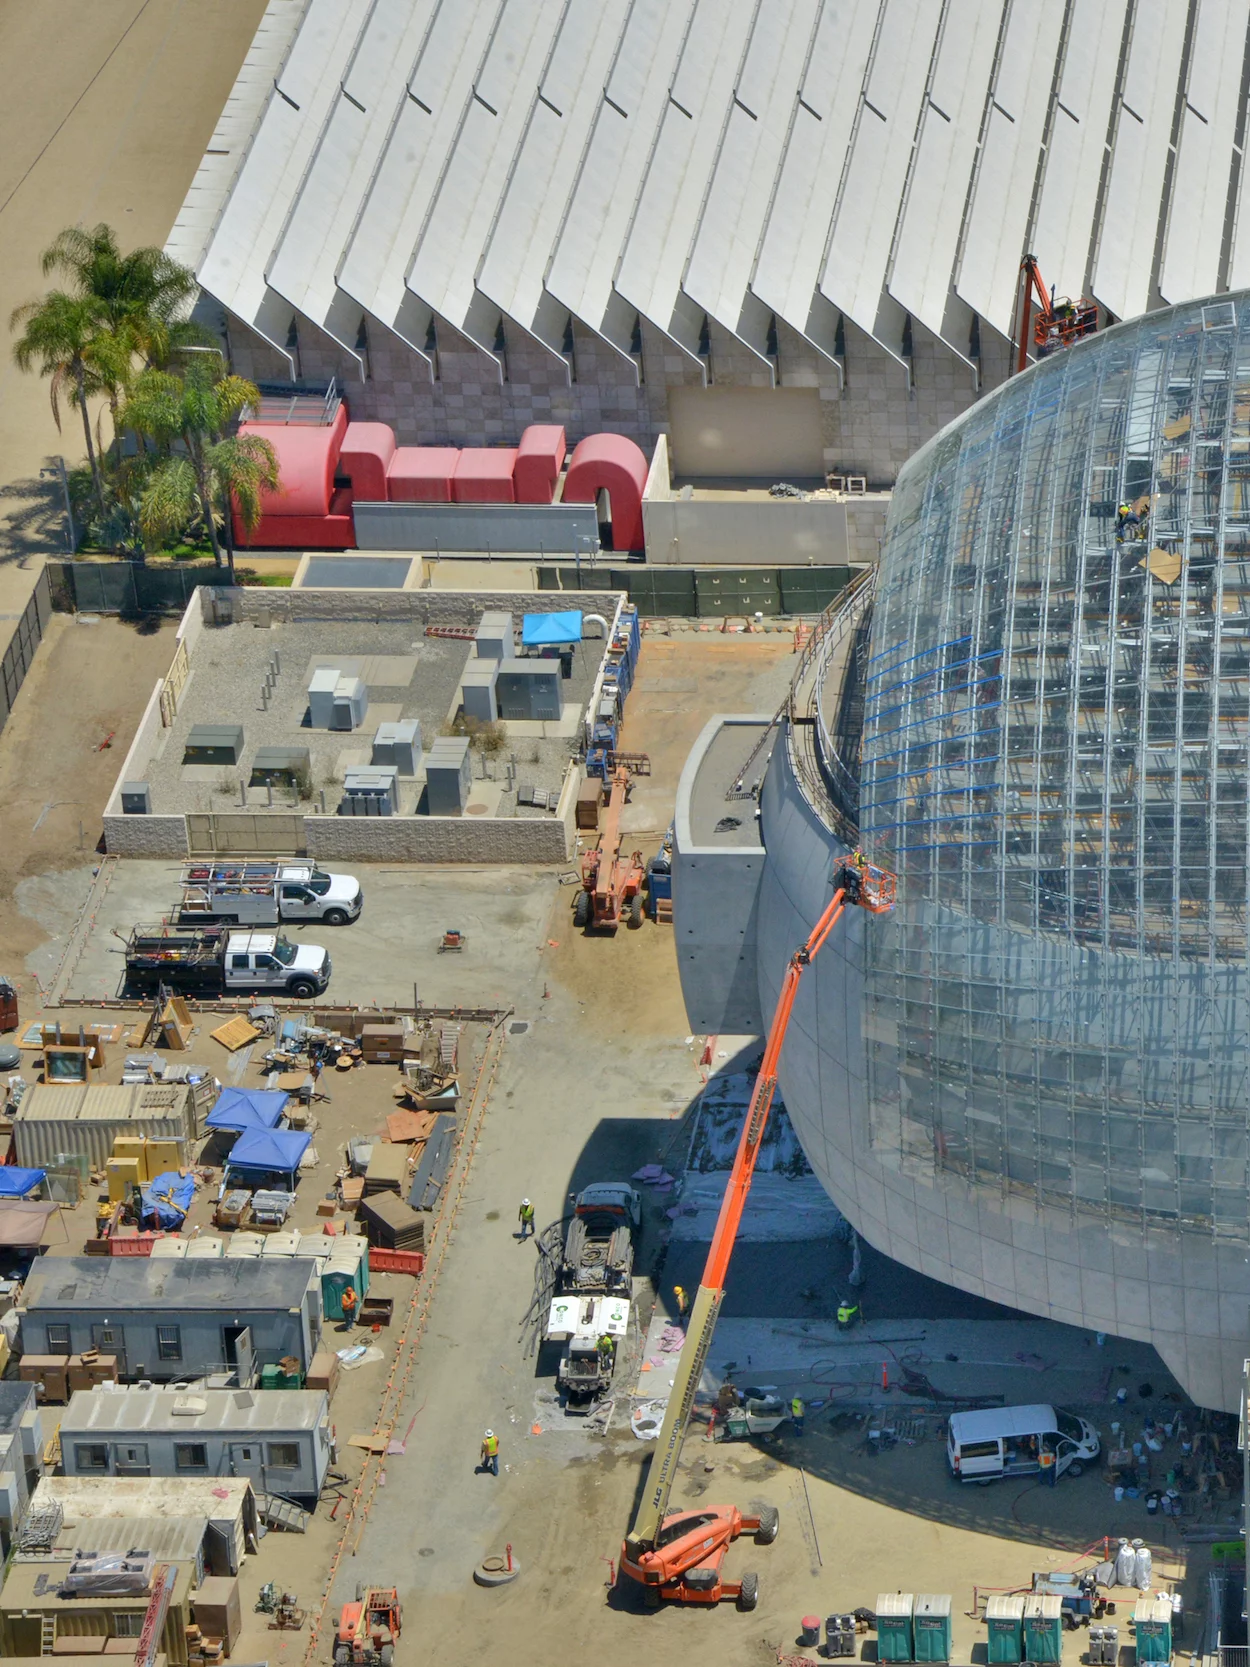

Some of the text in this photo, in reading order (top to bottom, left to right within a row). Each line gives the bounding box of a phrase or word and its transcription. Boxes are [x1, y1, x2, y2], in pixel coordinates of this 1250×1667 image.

[653, 1418, 681, 1509] JLG ULTRA BOOM
